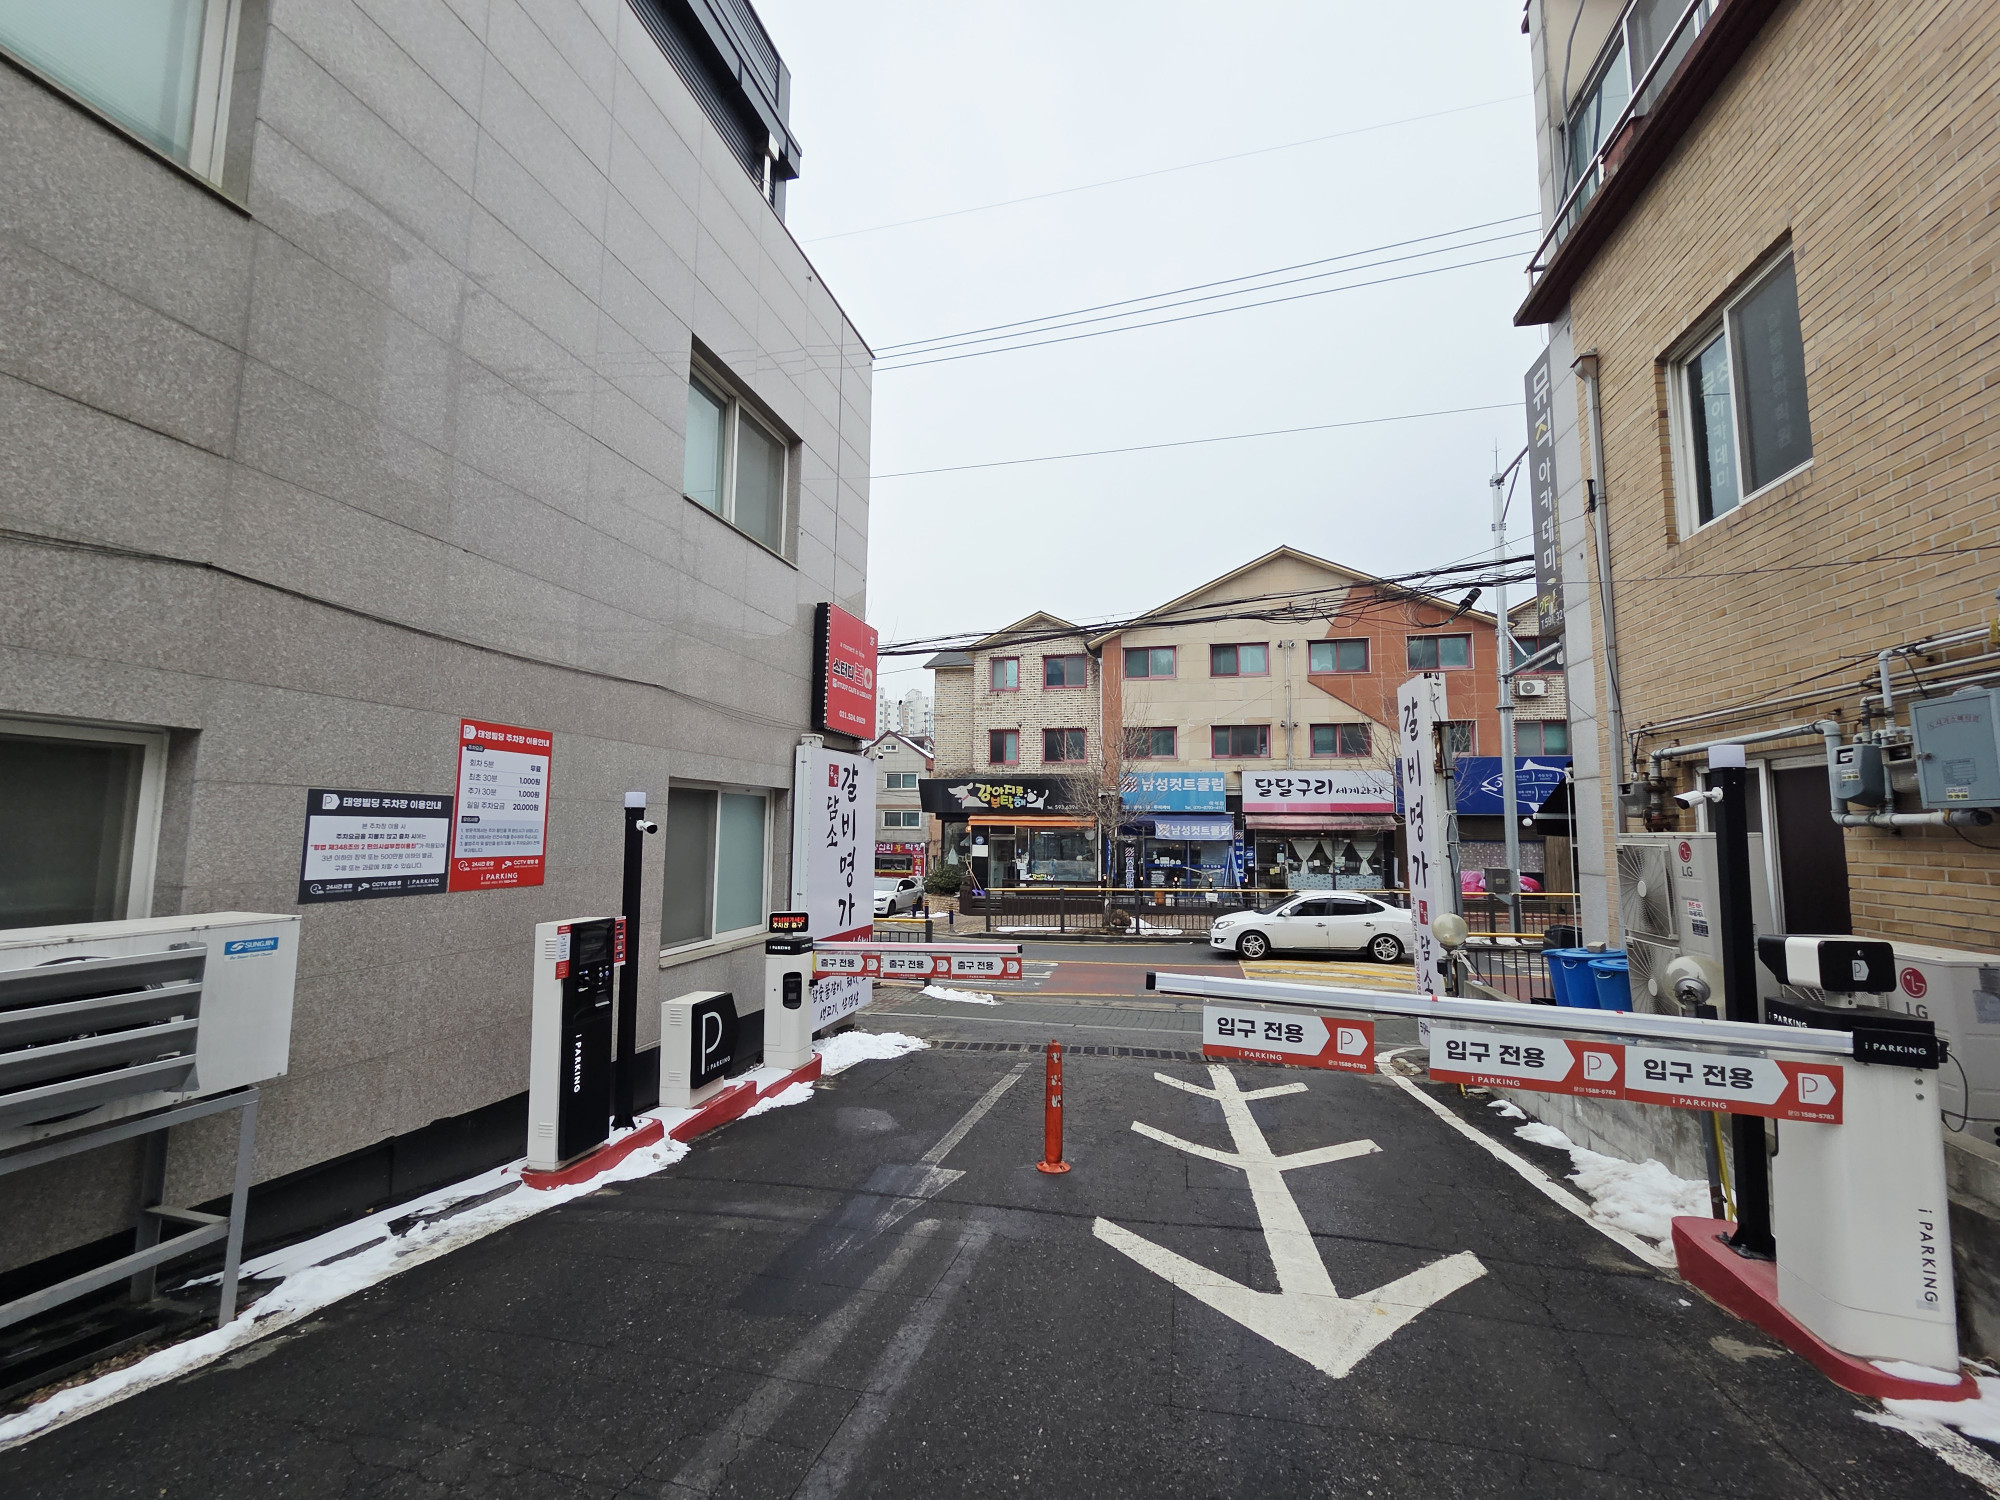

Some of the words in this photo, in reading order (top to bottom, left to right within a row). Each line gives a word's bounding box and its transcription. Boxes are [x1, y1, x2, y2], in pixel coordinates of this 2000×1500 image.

[1533, 362, 1553, 448] 뮤직
[1539, 457, 1556, 571] 아카데미
[478, 729, 504, 741] 태영빌딩
[506, 733, 525, 744] 주차장
[526, 736, 550, 747] 이용안내
[470, 759, 482, 767] 회차
[484, 760, 494, 768] 5분
[469, 773, 481, 781] 최초
[483, 774, 498, 782] 30분
[468, 787, 480, 795] 추가
[482, 788, 496, 796] 30분
[1255, 778, 1333, 797] 달달구리
[1336, 786, 1384, 795] 세계과자
[1404, 697, 1428, 889] 갈비명가
[343, 797, 380, 808] 태영빌딩
[382, 799, 408, 809] 주차장
[409, 800, 442, 810] 이용안내
[481, 802, 505, 810] 주차요금
[990, 795, 1027, 809] 부탁해
[826, 795, 839, 848] 담소
[837, 762, 859, 927] 갈비명가
[486, 872, 518, 880] PARKING
[1682, 866, 1693, 877] LG
[821, 958, 837, 968] 출구
[840, 958, 855, 968] 전용
[889, 959, 906, 969] 출구
[908, 959, 924, 969] 전용
[958, 961, 974, 970] 출구
[977, 961, 994, 971] 전용
[1421, 935, 1433, 994] 담소
[1905, 1001, 1928, 1020] LG
[1773, 1013, 1808, 1029] PARKING
[1217, 1016, 1256, 1038] 입구
[1263, 1021, 1304, 1043] 전용
[1445, 1039, 1491, 1063] 입구
[1499, 1044, 1545, 1068] 전용
[1865, 1041, 1869, 1050] i
[1873, 1043, 1927, 1055] PARKING
[710, 1055, 731, 1070] PARKING
[1244, 1050, 1283, 1061] PARKING
[573, 1041, 582, 1093] PARKING
[1643, 1058, 1694, 1083] 입구
[1702, 1064, 1754, 1089] 전용
[1477, 1076, 1521, 1087] PARKING
[1679, 1097, 1727, 1109] PARKING
[1800, 1111, 1835, 1120] 1588-5783
[1919, 1221, 1938, 1303] PARKING
